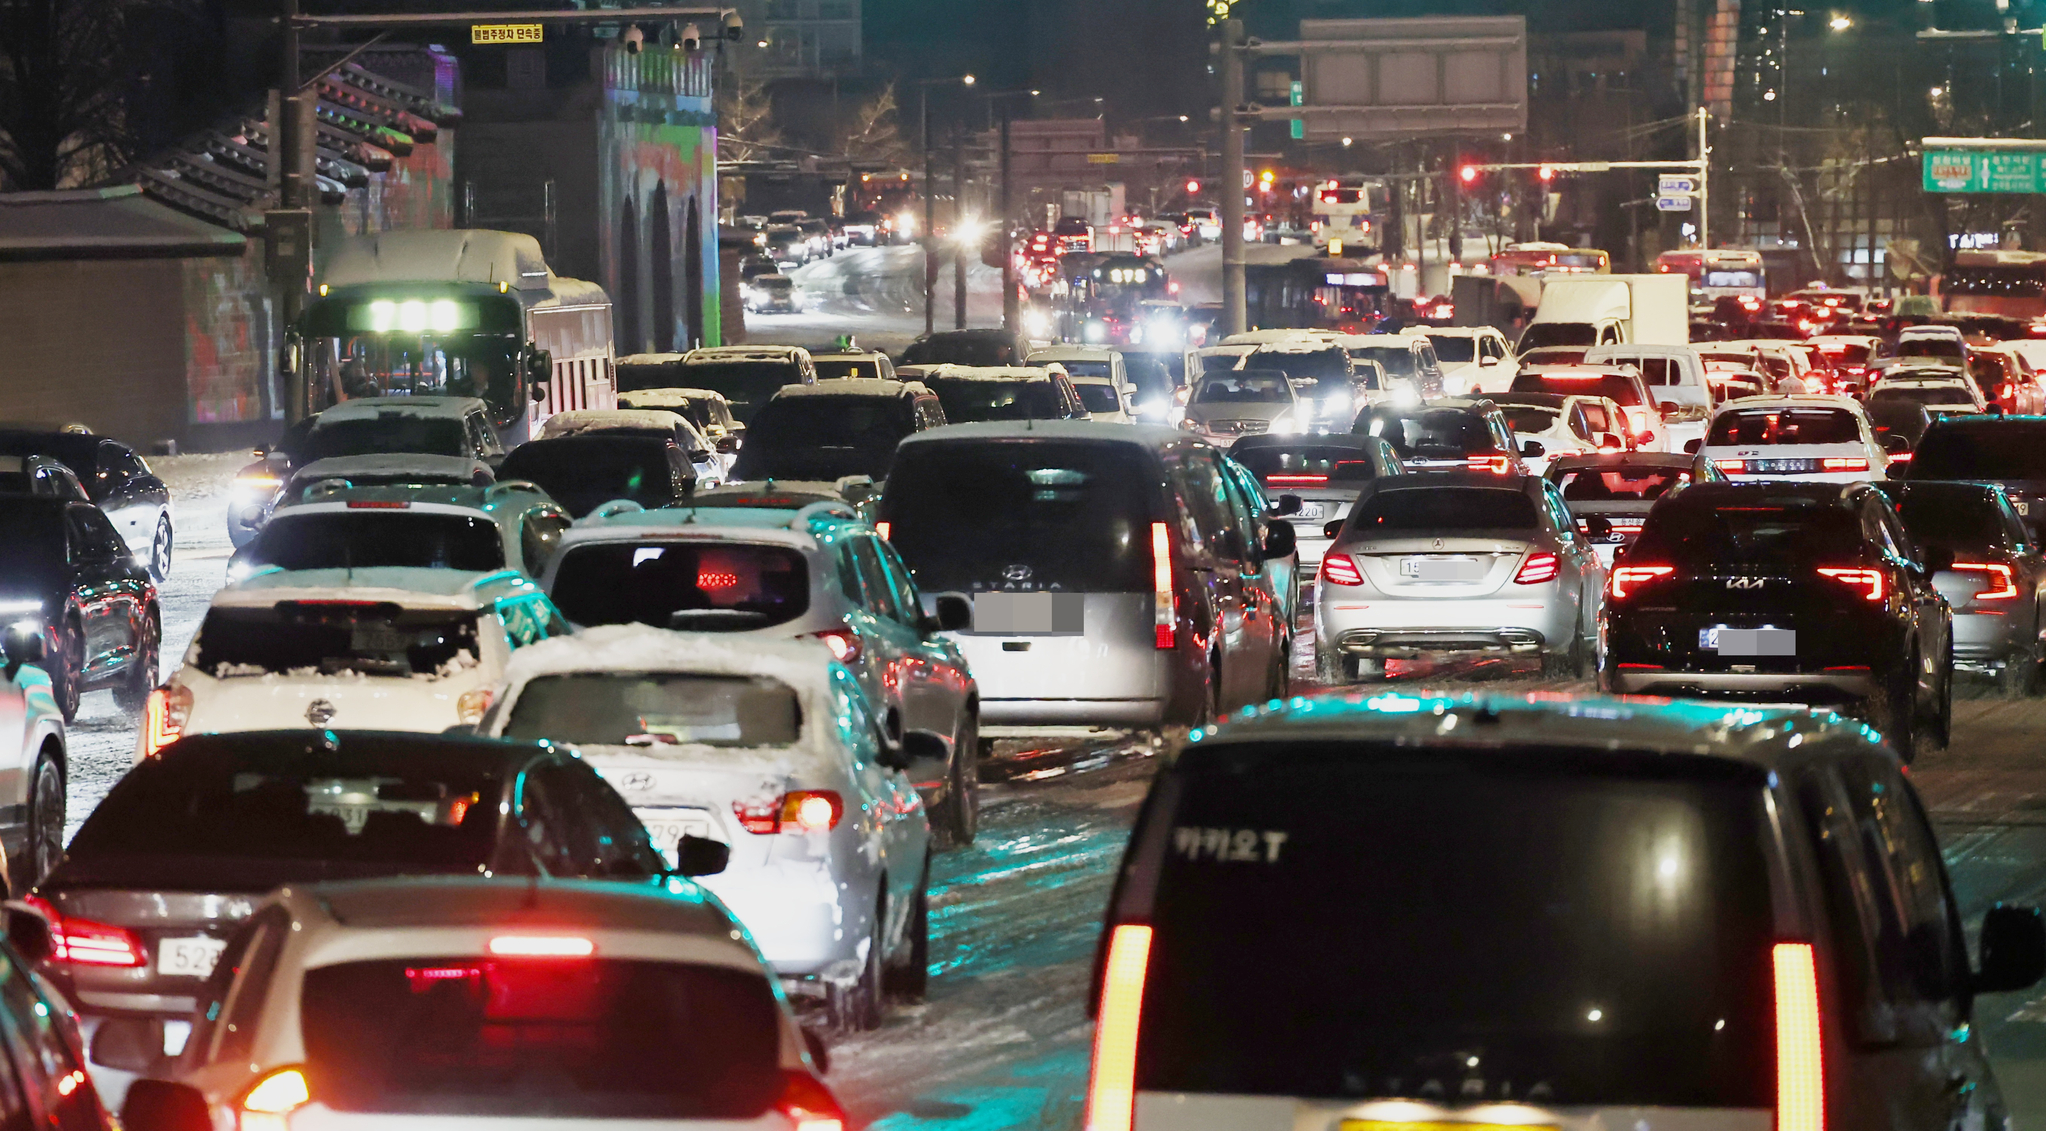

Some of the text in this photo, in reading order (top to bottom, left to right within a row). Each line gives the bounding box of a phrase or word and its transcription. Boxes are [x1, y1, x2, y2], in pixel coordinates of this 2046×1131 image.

[474, 28, 541, 41] 불법주정차 단속중
[973, 581, 1061, 590] STARIA
[1726, 578, 1764, 589] KIA
